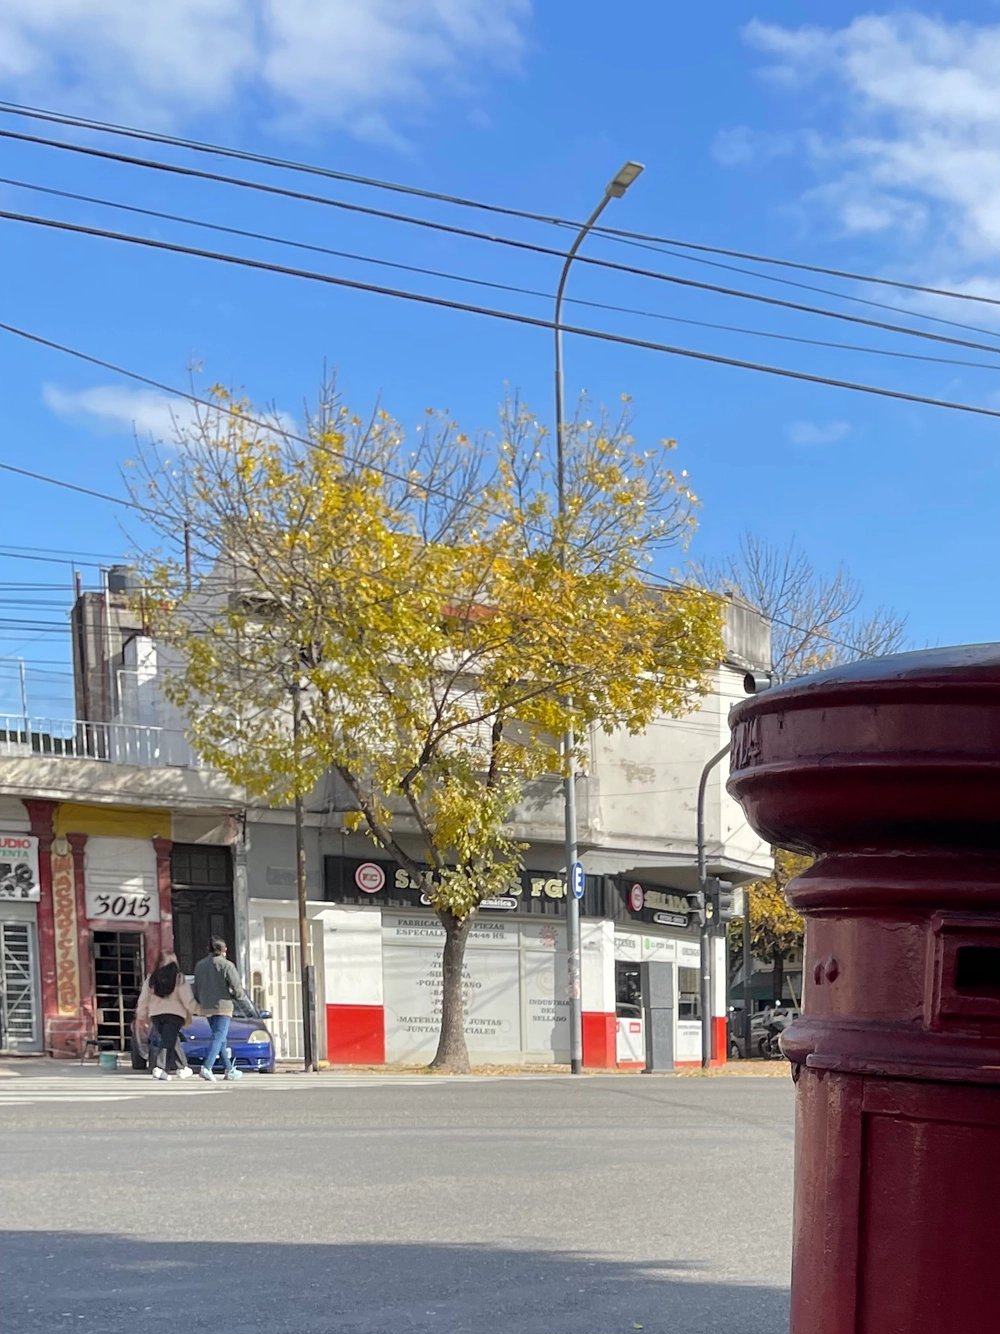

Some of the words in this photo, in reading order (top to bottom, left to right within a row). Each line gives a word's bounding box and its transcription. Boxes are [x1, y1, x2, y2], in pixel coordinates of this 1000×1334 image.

[530, 877, 568, 899] FG
[575, 867, 583, 893] E
[94, 894, 151, 918] 3015
[396, 929, 446, 937] ESPECIALE
